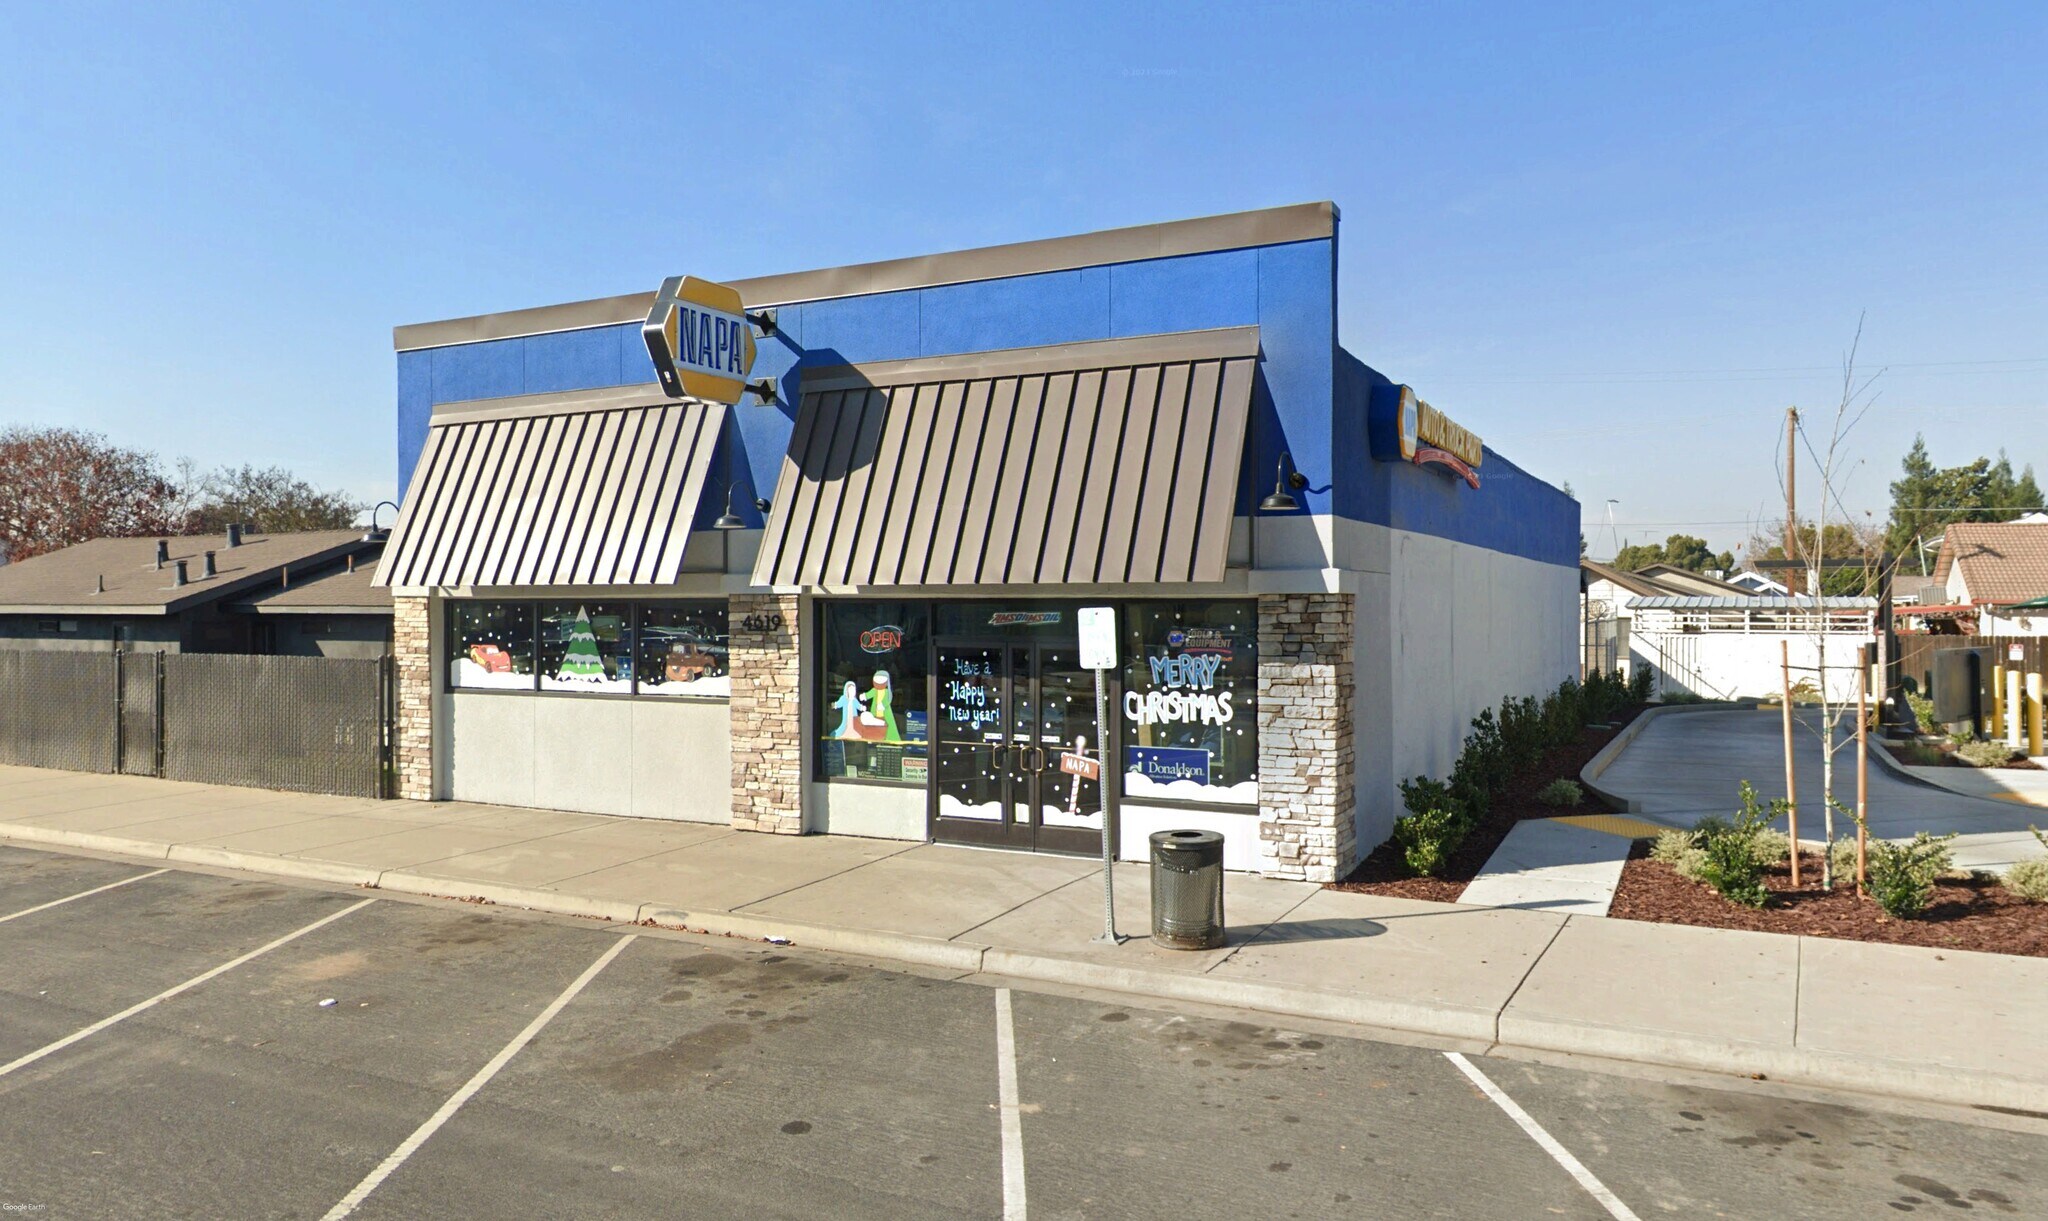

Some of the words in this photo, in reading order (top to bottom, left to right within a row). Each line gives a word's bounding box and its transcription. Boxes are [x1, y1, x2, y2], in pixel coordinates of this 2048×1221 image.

[680, 306, 743, 375] NAPA
[745, 614, 797, 631] 4619
[860, 631, 901, 648] OPEN
[1185, 638, 1232, 649] EQUIPMENT
[953, 658, 980, 676] Have
[983, 661, 992, 675] a
[1149, 653, 1221, 691] MERRY
[950, 681, 985, 707] Happy
[970, 707, 1000, 730] year!
[1123, 691, 1234, 726] CHRISTMAS
[1065, 758, 1091, 774] NAPA
